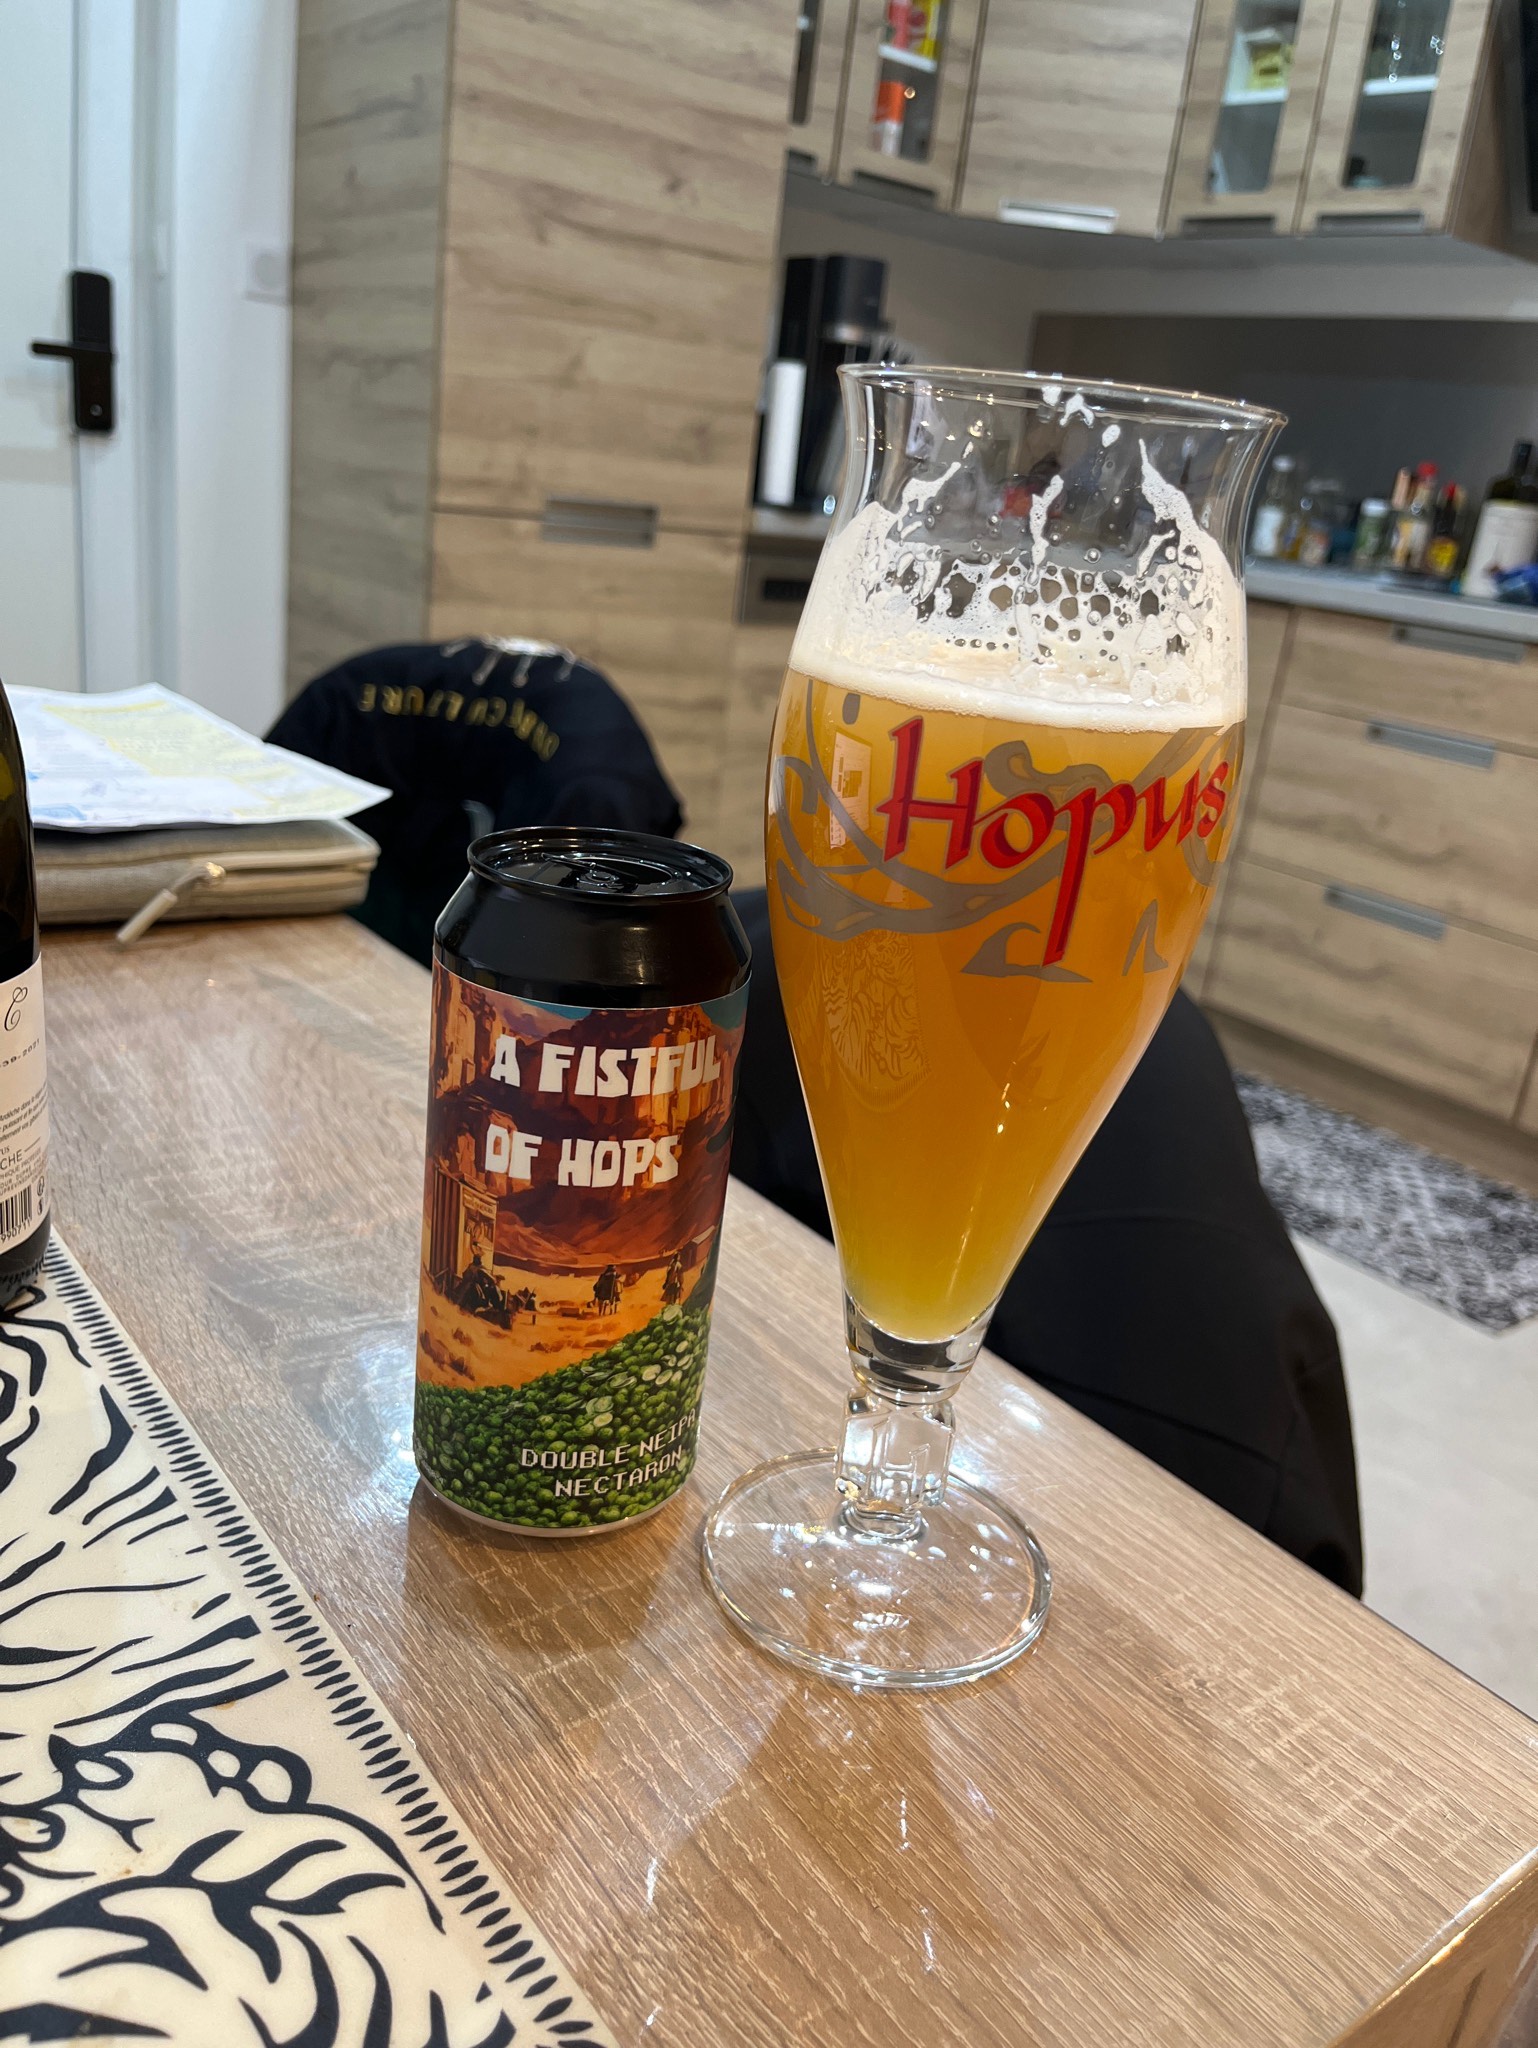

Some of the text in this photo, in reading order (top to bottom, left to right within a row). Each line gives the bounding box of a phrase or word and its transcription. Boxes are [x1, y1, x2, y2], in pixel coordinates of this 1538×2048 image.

[876, 715, 1230, 967] Hopus
[490, 1034, 721, 1098] A FISTFUL
[485, 1123, 681, 1188] OF HOPS
[521, 1408, 697, 1470] DOUBLE NEIPA
[555, 1445, 683, 1498] NECTARON
